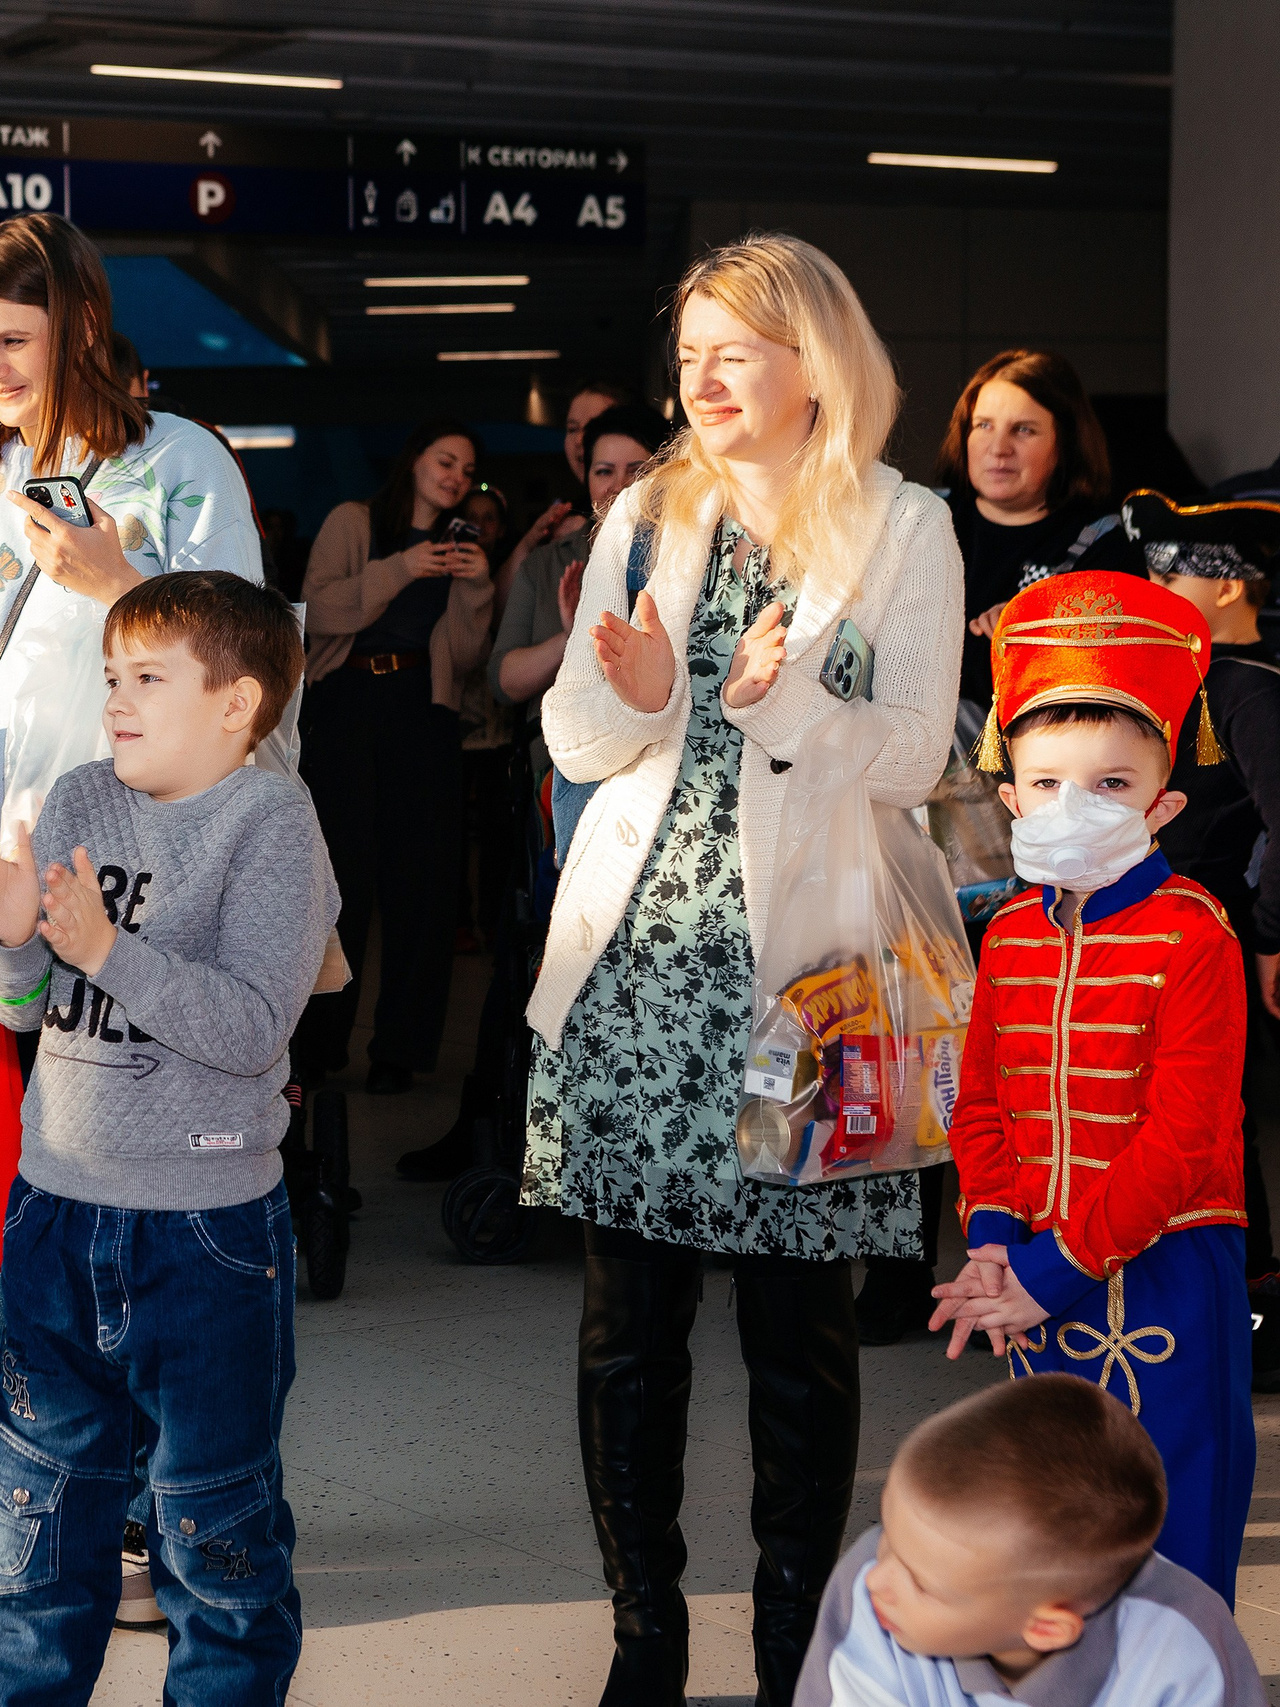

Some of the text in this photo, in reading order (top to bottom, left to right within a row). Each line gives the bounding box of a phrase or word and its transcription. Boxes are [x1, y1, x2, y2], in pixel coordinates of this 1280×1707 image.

[467, 145, 597, 170] К СЕКТОРАМ
[196, 179, 227, 216] P
[482, 190, 627, 230] А4 А5
[43, 978, 154, 1043] WIL
[767, 1049, 791, 1059] mama
[775, 1057, 791, 1067] vita
